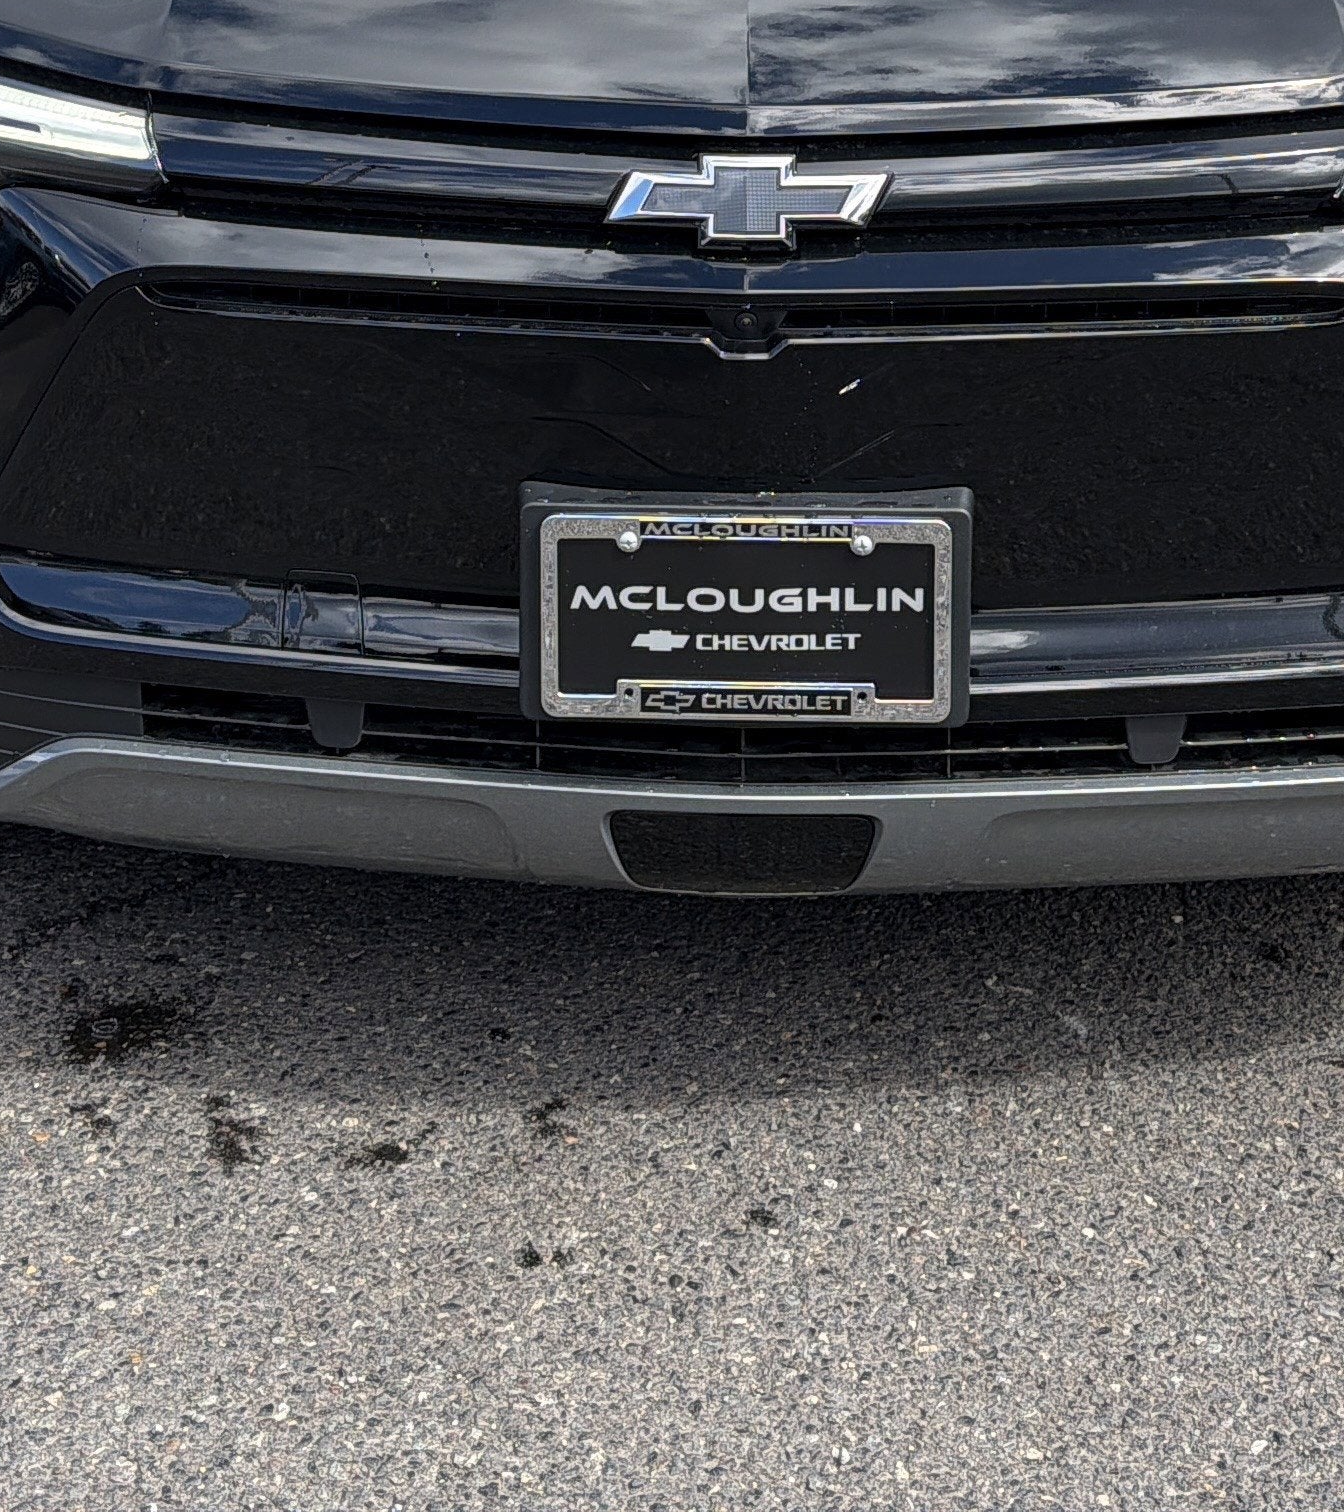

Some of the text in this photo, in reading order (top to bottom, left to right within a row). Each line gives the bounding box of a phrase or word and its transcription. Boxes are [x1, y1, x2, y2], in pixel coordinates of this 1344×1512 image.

[643, 522, 850, 538] MCLOUGHLIN
[569, 584, 925, 614] MCLOUGHLIN
[695, 632, 862, 652] CHEVROLET
[700, 692, 849, 712] CHEVROLET
